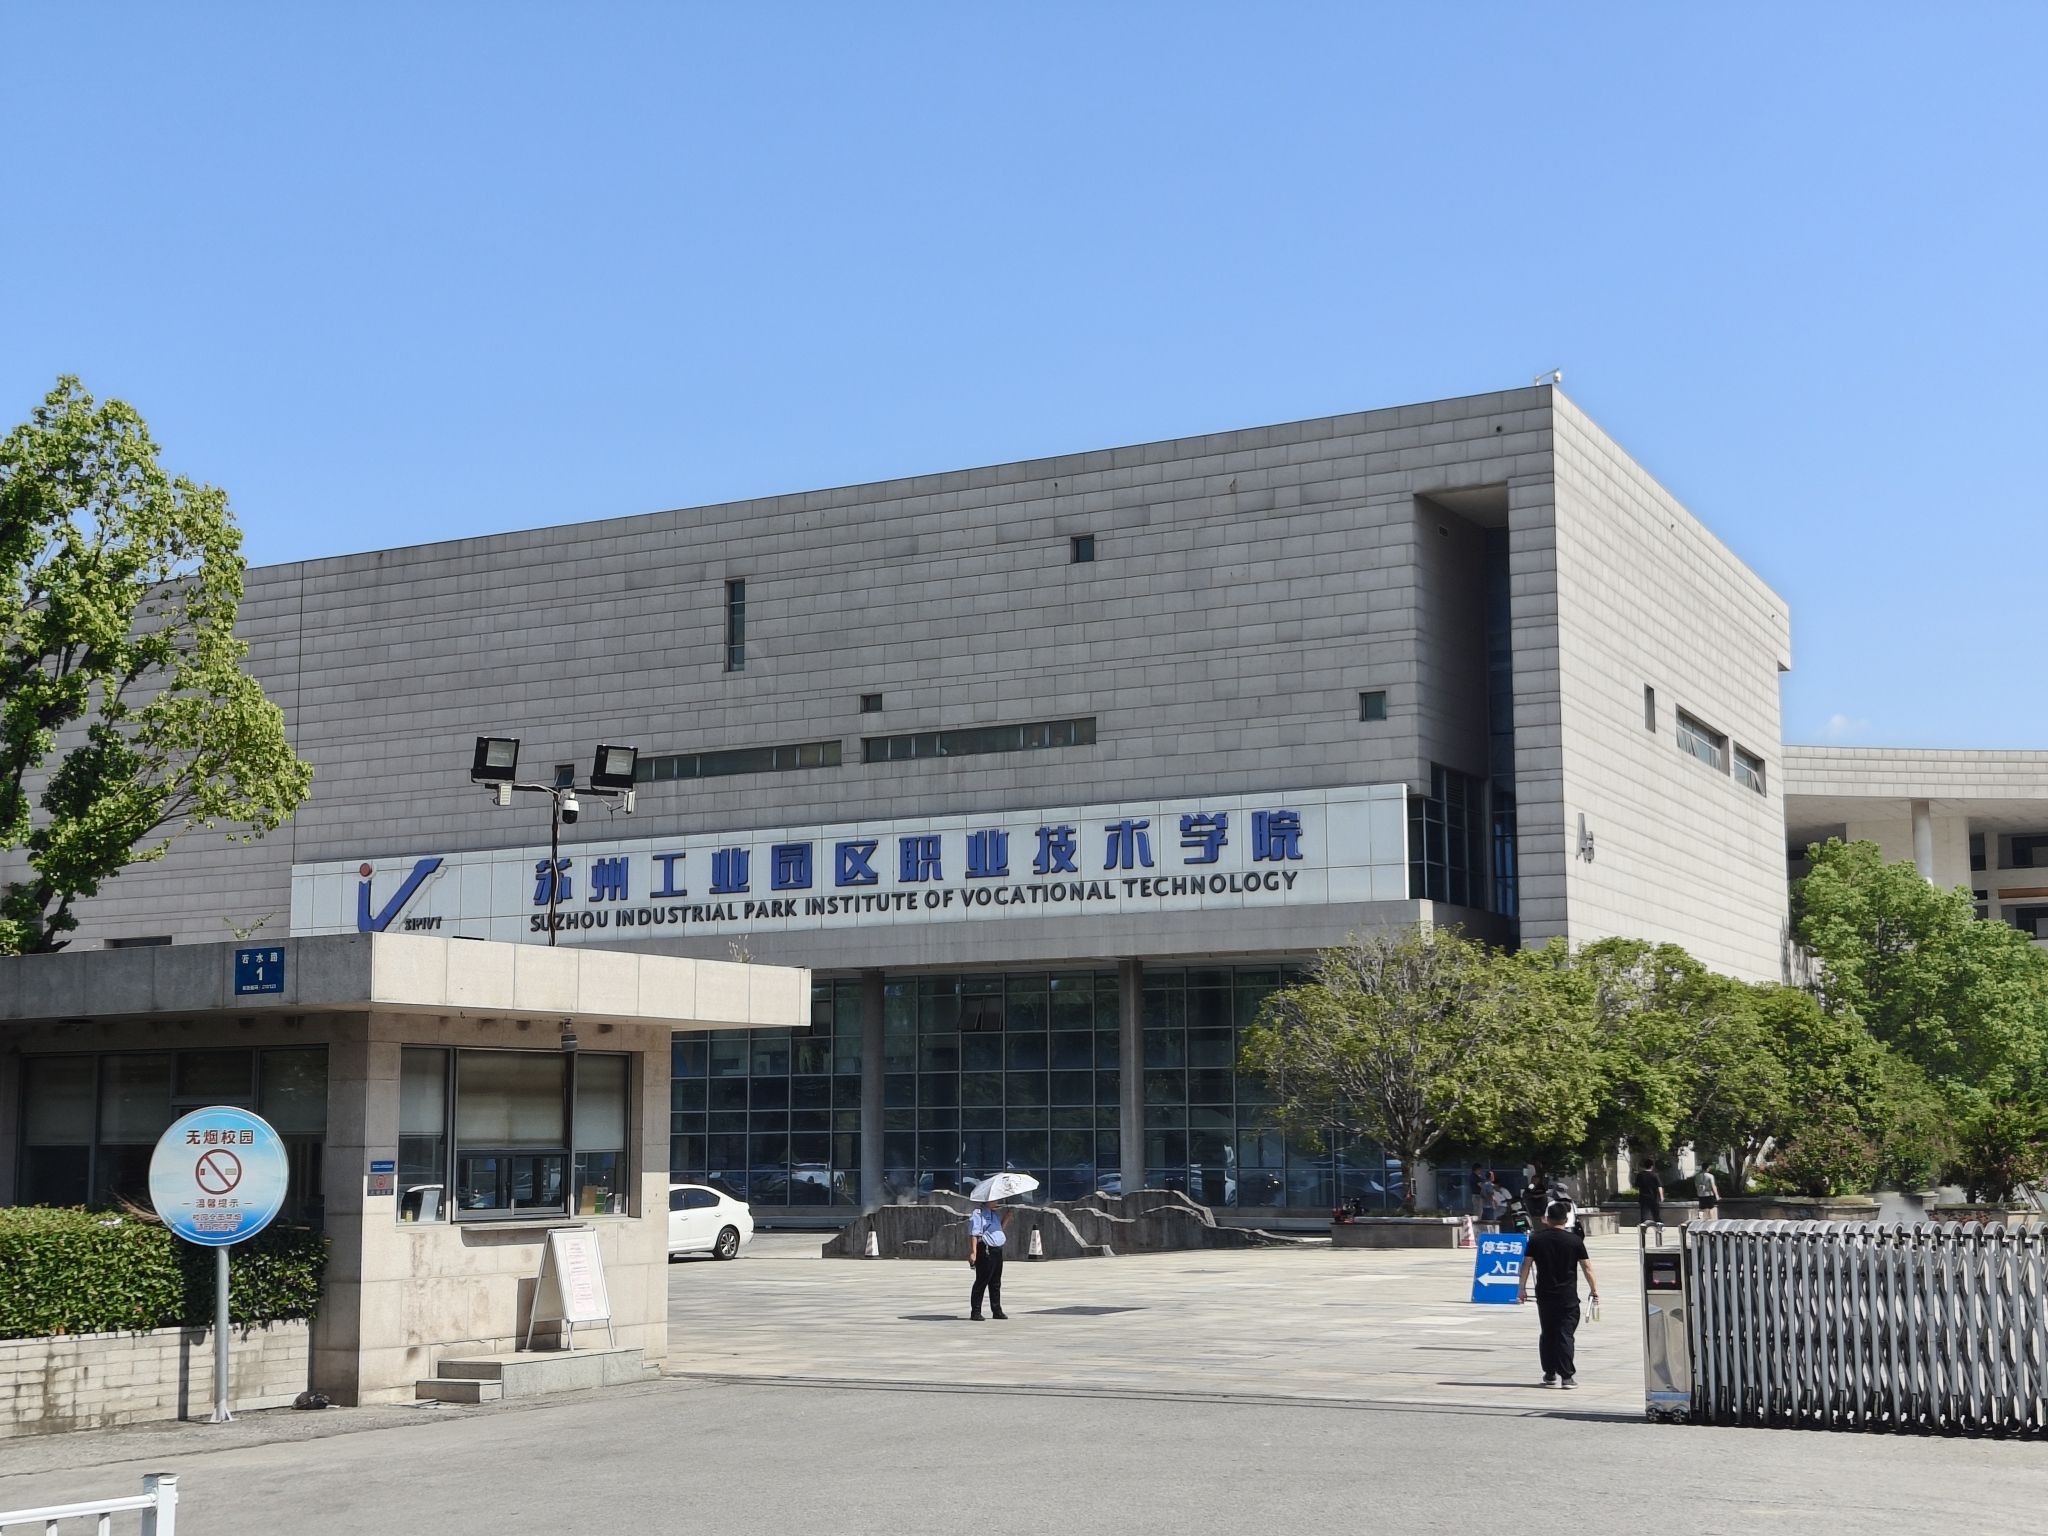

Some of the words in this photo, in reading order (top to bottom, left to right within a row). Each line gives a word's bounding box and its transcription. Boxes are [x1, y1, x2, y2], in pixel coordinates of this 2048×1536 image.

[533, 810, 1303, 906] 苏州工业园区职业技术学院
[530, 911, 609, 932] SUZHOU
[616, 902, 738, 927] INDUSTRIAL
[744, 899, 797, 919] PARK
[804, 893, 918, 916] INSTITUTE
[923, 889, 954, 909] OF
[961, 881, 1116, 908] VOCATIONAL
[1122, 871, 1298, 898] TECHNOLOGY
[256, 966, 263, 981] 1
[185, 1129, 255, 1145] 无烟校园
[1481, 1240, 1523, 1255] 停车场
[1490, 1260, 1520, 1274] 入口
